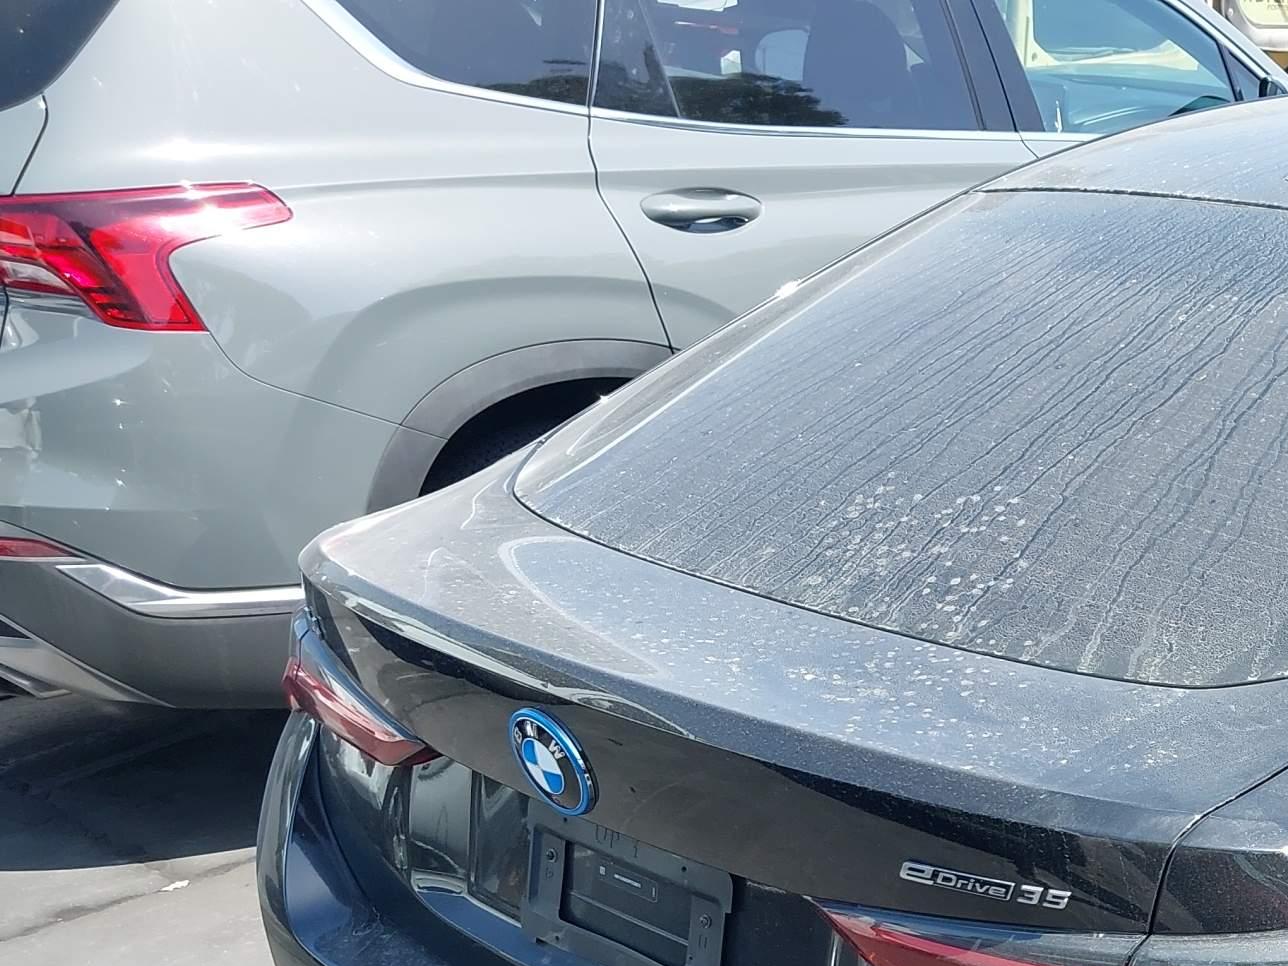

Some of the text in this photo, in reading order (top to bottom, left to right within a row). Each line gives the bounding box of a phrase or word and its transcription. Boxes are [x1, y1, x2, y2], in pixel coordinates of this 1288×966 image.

[513, 719, 567, 760] BMW
[900, 861, 1072, 910] eDrive 35
